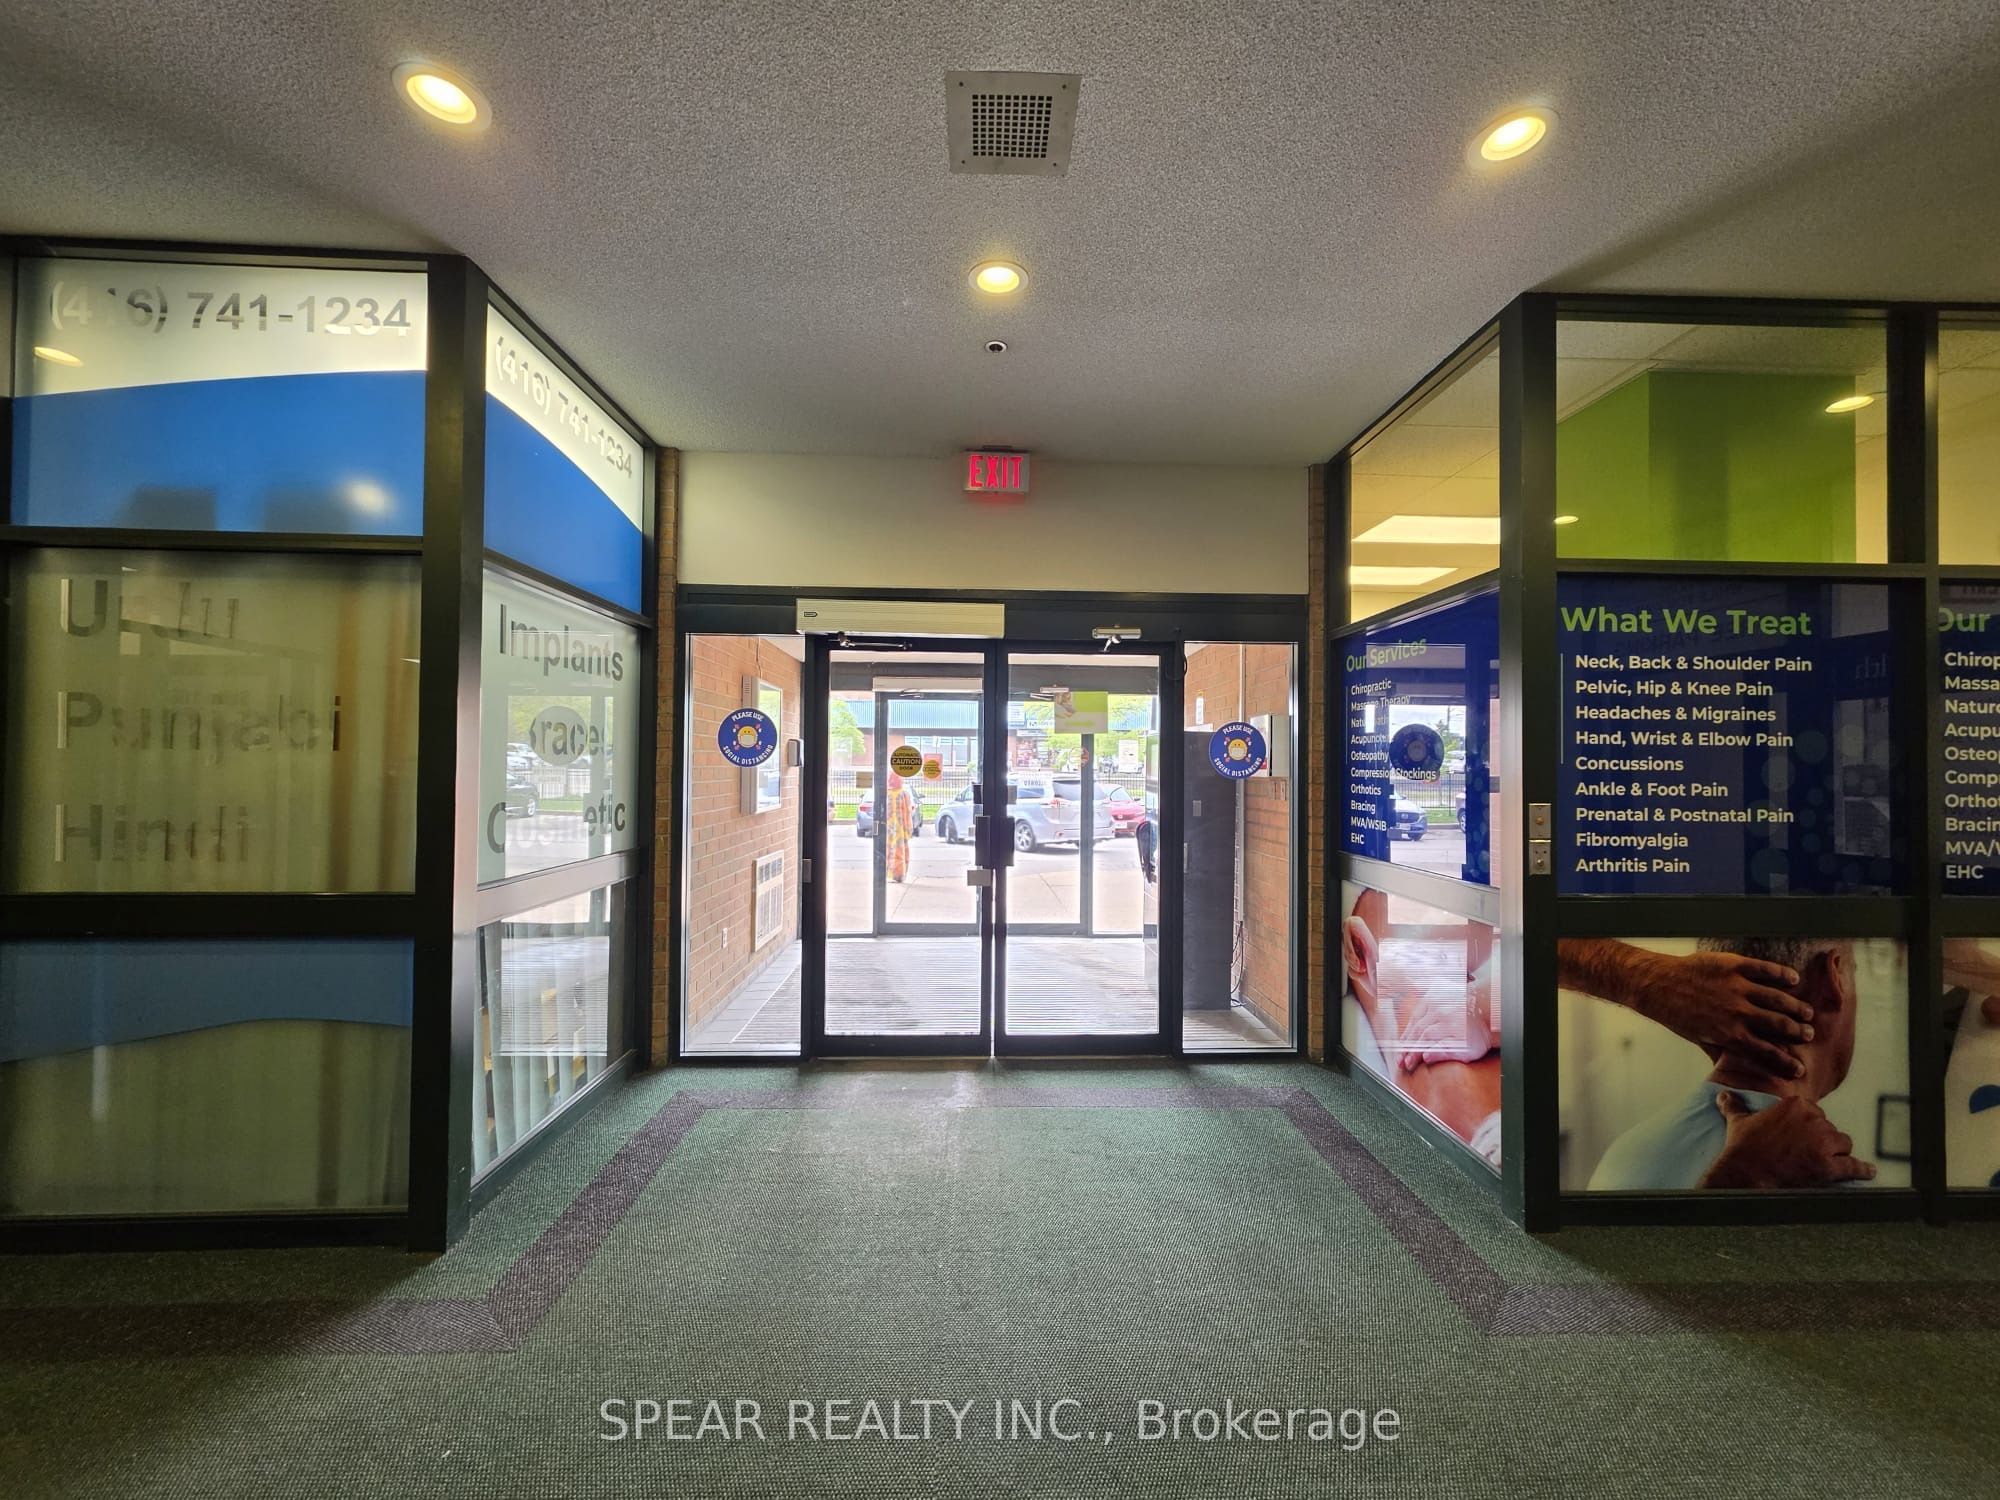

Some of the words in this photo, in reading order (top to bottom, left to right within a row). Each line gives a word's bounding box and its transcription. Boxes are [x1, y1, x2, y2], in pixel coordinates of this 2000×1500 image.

[50, 282, 168, 333] (46)
[187, 291, 411, 336] 741-1234
[495, 336, 552, 416] (416)
[558, 391, 633, 479] 741-1234
[969, 454, 1024, 488] EXIT
[60, 577, 240, 641] Udu
[1560, 606, 1653, 633] What
[1662, 608, 1718, 634] We
[1726, 609, 1812, 636] Treat
[500, 603, 624, 682] Implants
[1346, 654, 1368, 673] Our
[1369, 639, 1427, 667] Services
[1575, 655, 1625, 672] Neck,
[1629, 655, 1673, 670] Back
[1676, 656, 1689, 670] &
[1692, 656, 1771, 671] Shoulder
[1774, 657, 1813, 672] Pain
[1350, 678, 1392, 696] Chiropractic
[1575, 679, 1633, 697] Pelvic,
[1636, 680, 1667, 698] Hip
[1670, 681, 1682, 695] &
[1687, 682, 1731, 696] Knee
[1735, 681, 1774, 697] Pain
[731, 711, 754, 722] PLEASE
[1575, 705, 1672, 720] Headaches
[1675, 706, 1688, 720] &
[1692, 706, 1777, 723] Migraines
[527, 716, 608, 757] race
[1223, 724, 1242, 735] PLEASE
[1575, 730, 1627, 748] Hand,
[1631, 731, 1677, 746] Wrist
[1681, 732, 1694, 746] &
[1698, 732, 1751, 746] Elbow
[1755, 732, 1794, 747] Pain
[723, 745, 741, 763] SOCIAL
[741, 744, 774, 765] DISTANCING
[892, 757, 921, 765] CAUTION
[1350, 749, 1390, 763] Osteopathy
[1575, 756, 1685, 771] Concussions
[1944, 746, 2000, 764] Osteo
[1214, 757, 1231, 776] SOCIAL
[1231, 757, 1263, 777] DISTANCING
[1350, 767, 1395, 781] Compressio
[1395, 767, 1437, 783] Stockings
[1944, 770, 2000, 788] Comp
[1350, 783, 1382, 796] Orthotics
[1575, 782, 1627, 796] Ankle
[1631, 783, 1643, 796] &
[1647, 782, 1686, 796] Foot
[1691, 782, 1729, 797] Pain
[1350, 799, 1376, 814] Bracing
[1944, 793, 2000, 808] Ortho
[1350, 816, 1387, 831] MVA/WSIB
[1575, 807, 1649, 822] Prenatal
[1653, 808, 1666, 822] &
[1670, 808, 1751, 823] Postnatal
[1756, 808, 1795, 823] Pain
[487, 794, 627, 855] Cosetic
[1350, 832, 1365, 845] EHC
[1575, 832, 1689, 850] Fibromyalgia
[1945, 839, 2000, 857] MVA/
[1575, 857, 1648, 873] Arthritis
[1652, 857, 1691, 873] Pain
[1945, 864, 1985, 879] EHC
